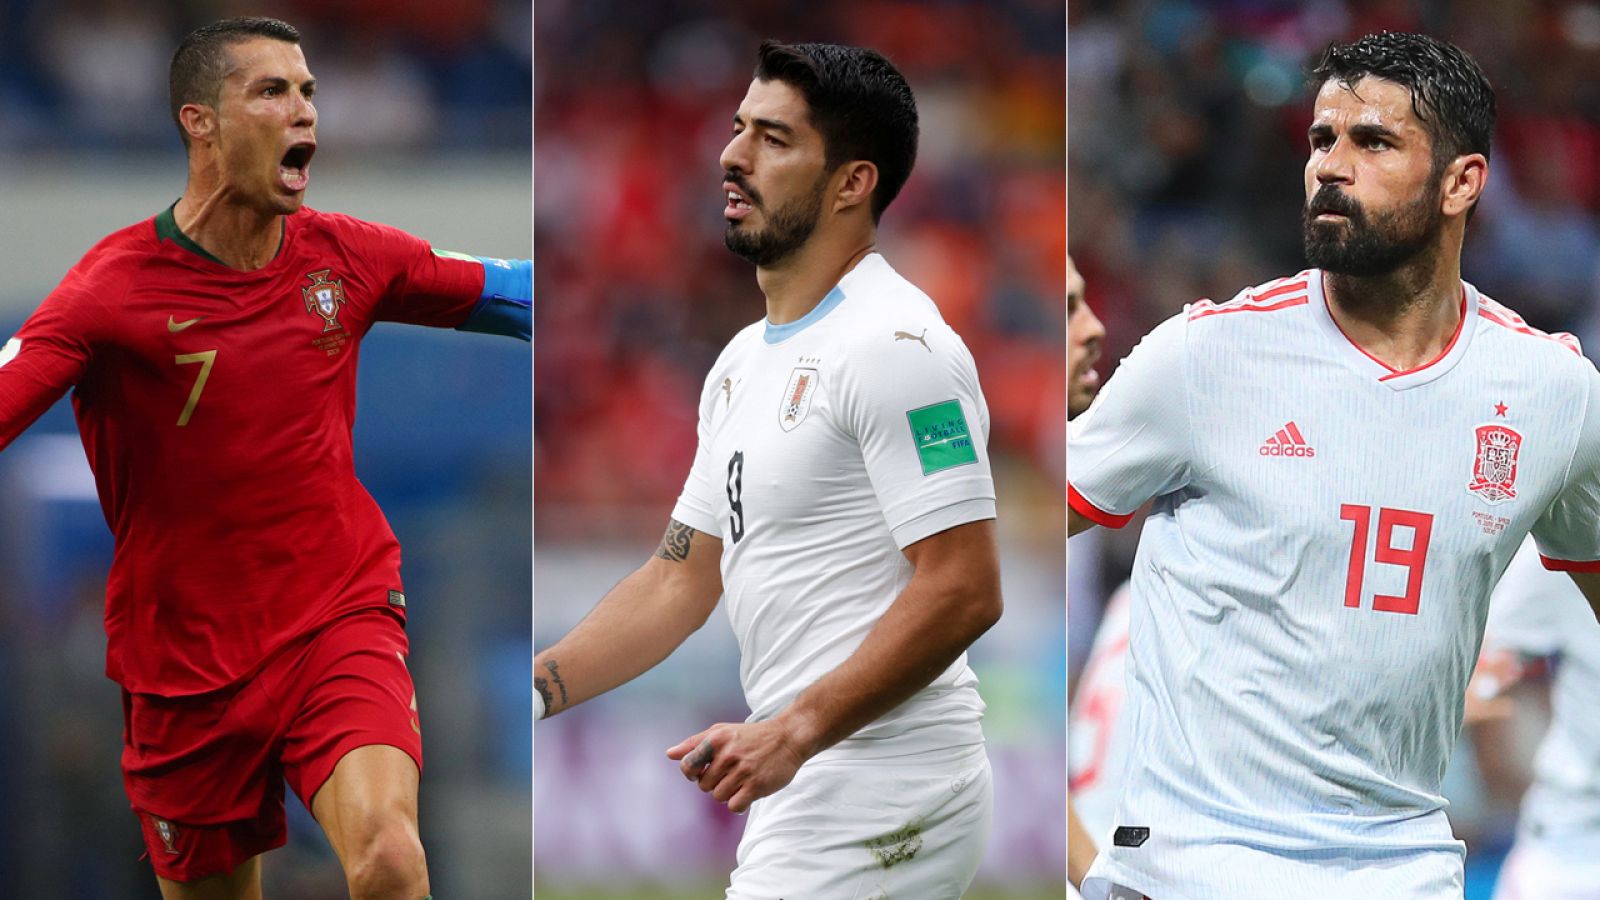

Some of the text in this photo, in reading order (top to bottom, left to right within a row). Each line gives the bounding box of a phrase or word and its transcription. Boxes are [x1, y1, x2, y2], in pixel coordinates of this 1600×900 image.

[175, 349, 218, 427] 7
[915, 418, 964, 436] LIVING
[952, 439, 971, 449] FIFA
[1259, 443, 1315, 458] adidas
[726, 450, 745, 545] 9
[1340, 503, 1434, 615] 19
